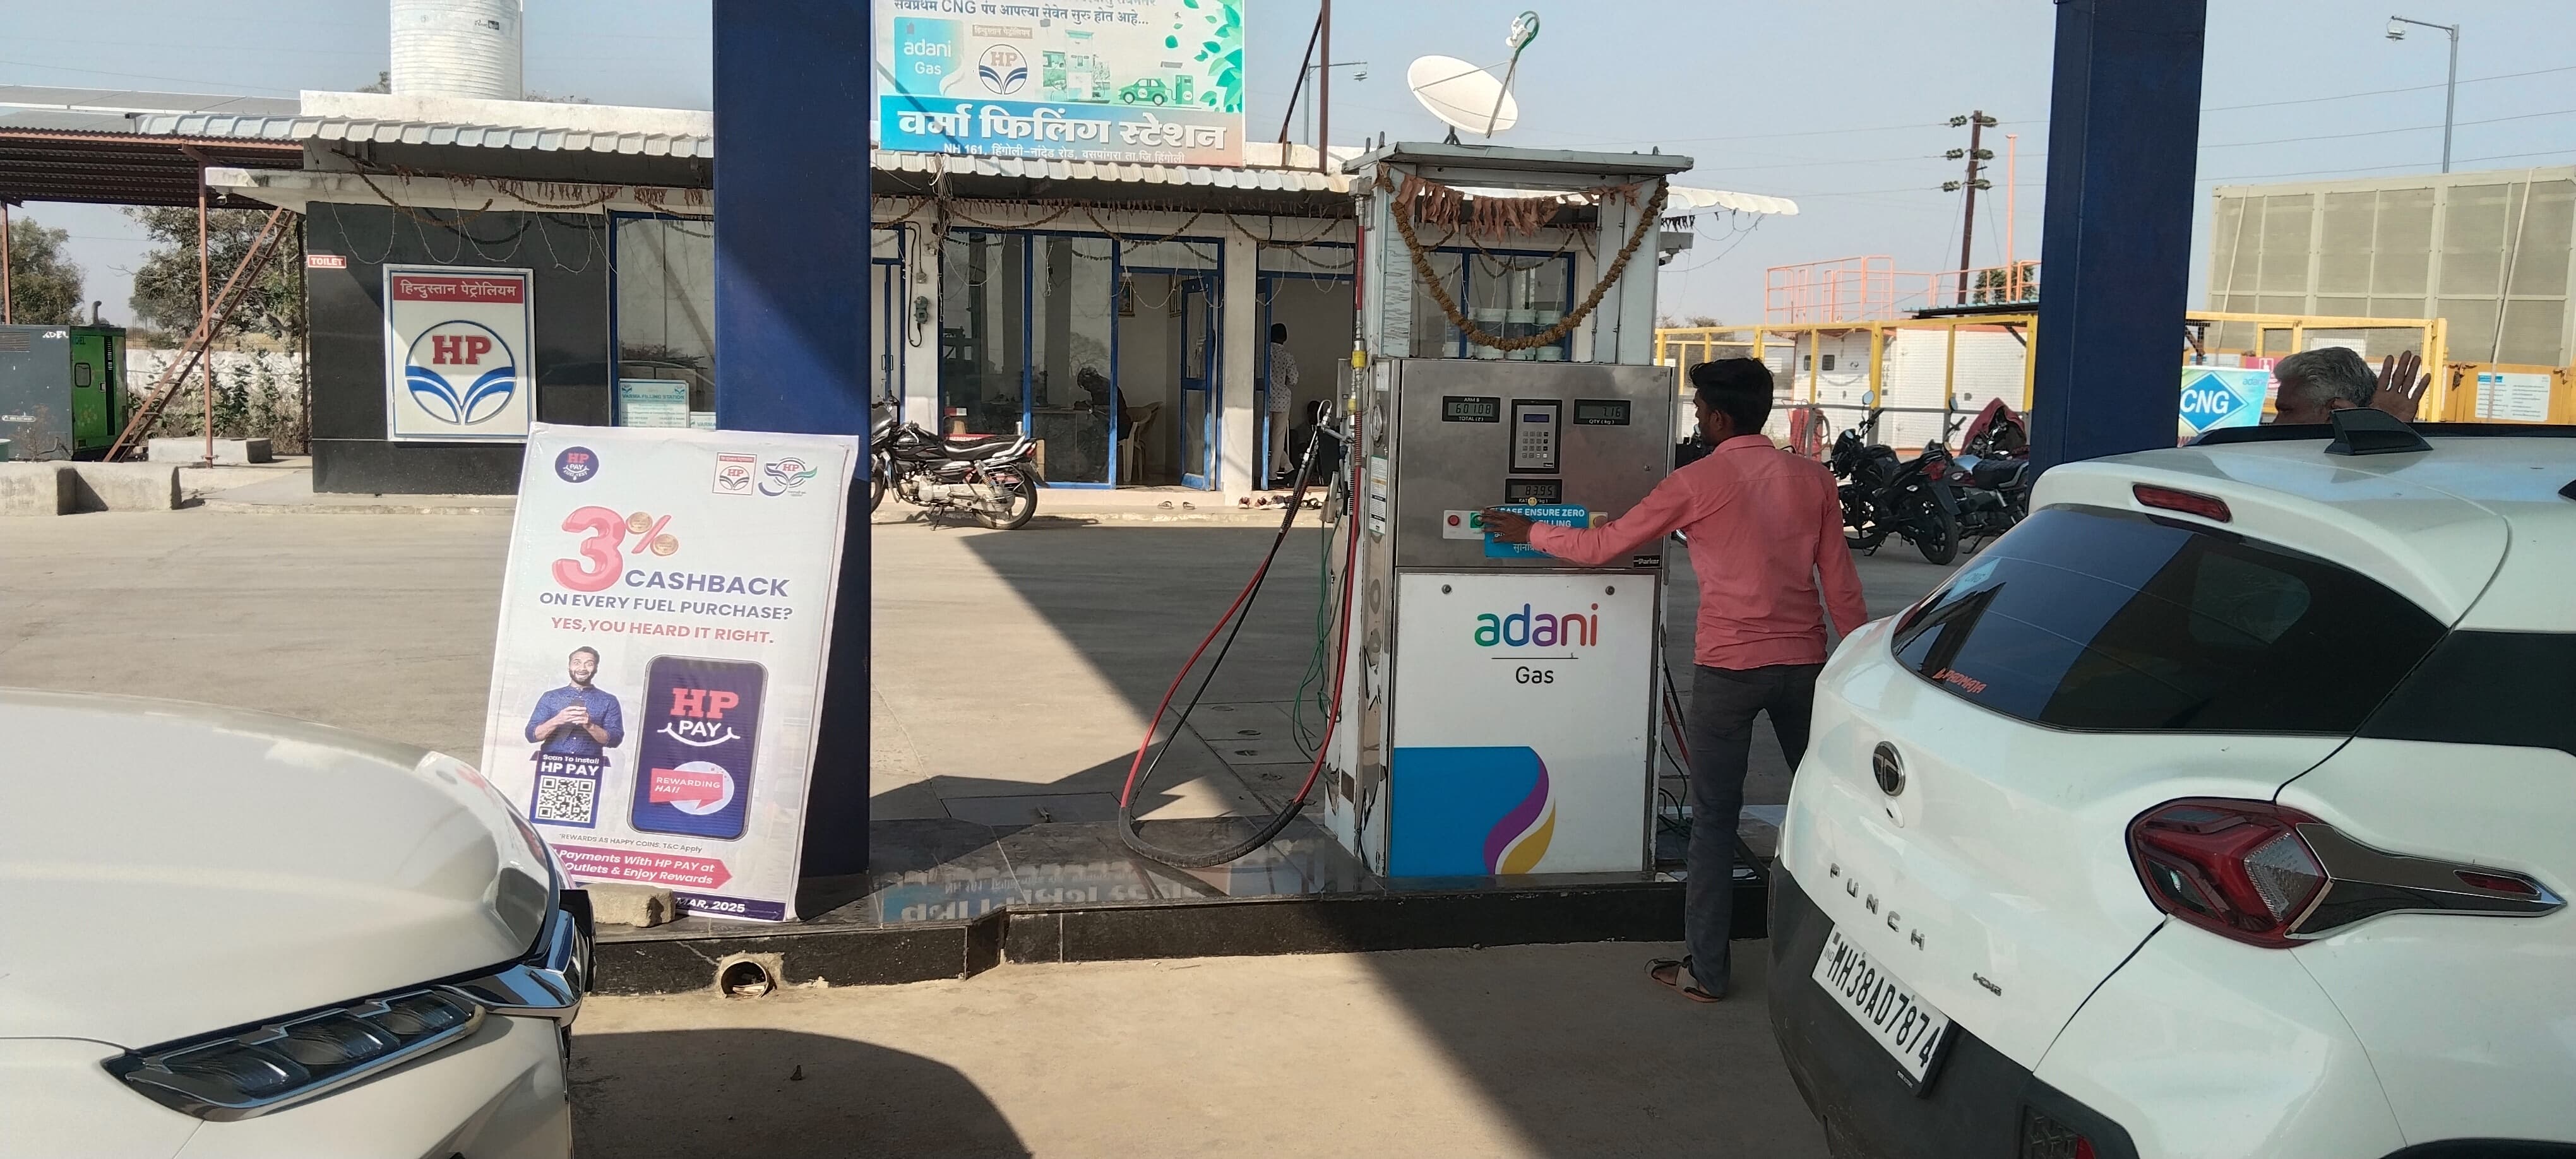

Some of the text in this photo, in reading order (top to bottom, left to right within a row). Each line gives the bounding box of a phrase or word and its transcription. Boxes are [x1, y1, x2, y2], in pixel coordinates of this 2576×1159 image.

[941, 0, 976, 13] CNG
[981, 1, 996, 15] पंप
[999, 4, 1039, 18] आपल्या
[1042, 4, 1068, 20] सेवेत
[1094, 7, 1113, 23] होत
[903, 39, 951, 57] adani
[915, 61, 942, 75] Gas
[991, 51, 1017, 67] HP
[897, 103, 1227, 150] वर्मा फिलिंग स्टेशन
[944, 143, 961, 154] NH
[311, 257, 343, 266] TOILET
[400, 280, 516, 299] हिन्दुस्तान पेट्रोलियम
[432, 335, 491, 365] HP
[2180, 389, 2229, 414] CNG
[568, 453, 589, 463] HP
[782, 463, 799, 472] HP
[1525, 508, 1560, 516] ENSURE
[1561, 509, 1585, 517] ZERO
[625, 569, 790, 597] CASHBACK
[540, 592, 793, 620] ON EVERY FUEL PURCHASE?
[629, 622, 691, 638] HEARD
[694, 627, 711, 639] IT
[714, 628, 774, 644] RIGHT.
[1474, 603, 1599, 647] adani
[1515, 666, 1554, 684] Gas
[670, 687, 739, 719] HP
[679, 720, 722, 737] PAY
[541, 761, 599, 776] HP PAY
[656, 776, 721, 789] REWARDING
[680, 845, 703, 853] Apply
[559, 850, 621, 864] Payments
[624, 855, 652, 867] With
[655, 859, 672, 868] HP
[674, 860, 700, 871] PAY
[700, 864, 715, 872] at
[565, 862, 713, 884] Outlets & Enjoy Rewards
[710, 901, 746, 913] 2025
[1829, 862, 1925, 951] PUNCH
[1827, 941, 1941, 1068] MH38AD7874
